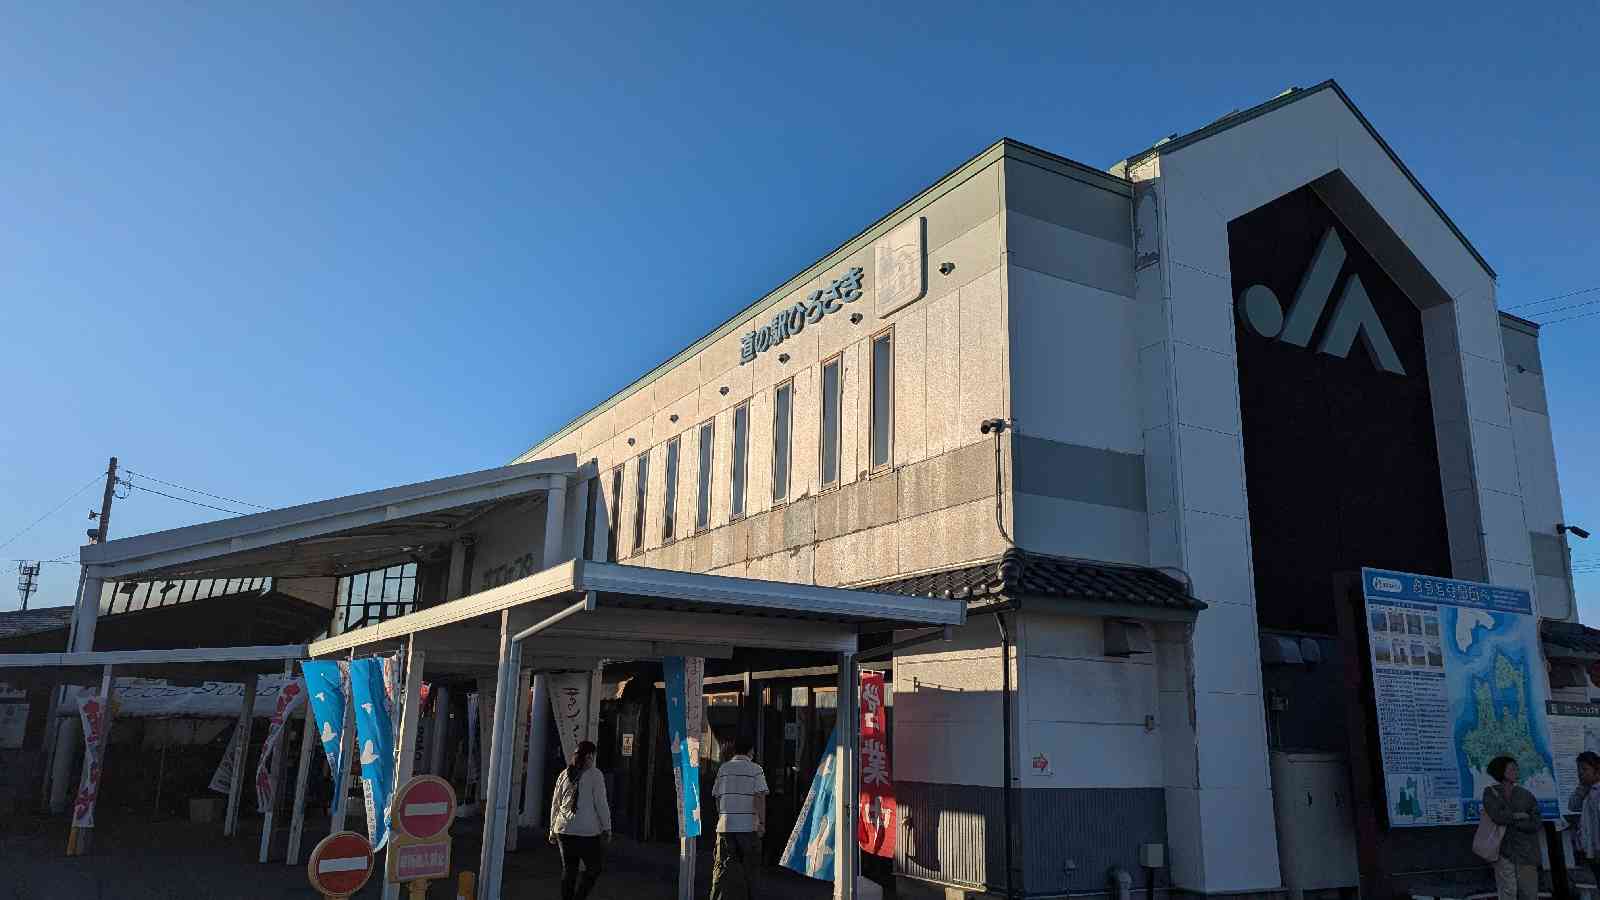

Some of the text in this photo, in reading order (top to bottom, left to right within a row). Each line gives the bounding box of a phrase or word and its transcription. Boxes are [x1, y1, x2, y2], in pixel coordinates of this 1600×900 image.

[740, 267, 864, 365] 道の駅ひろさき
